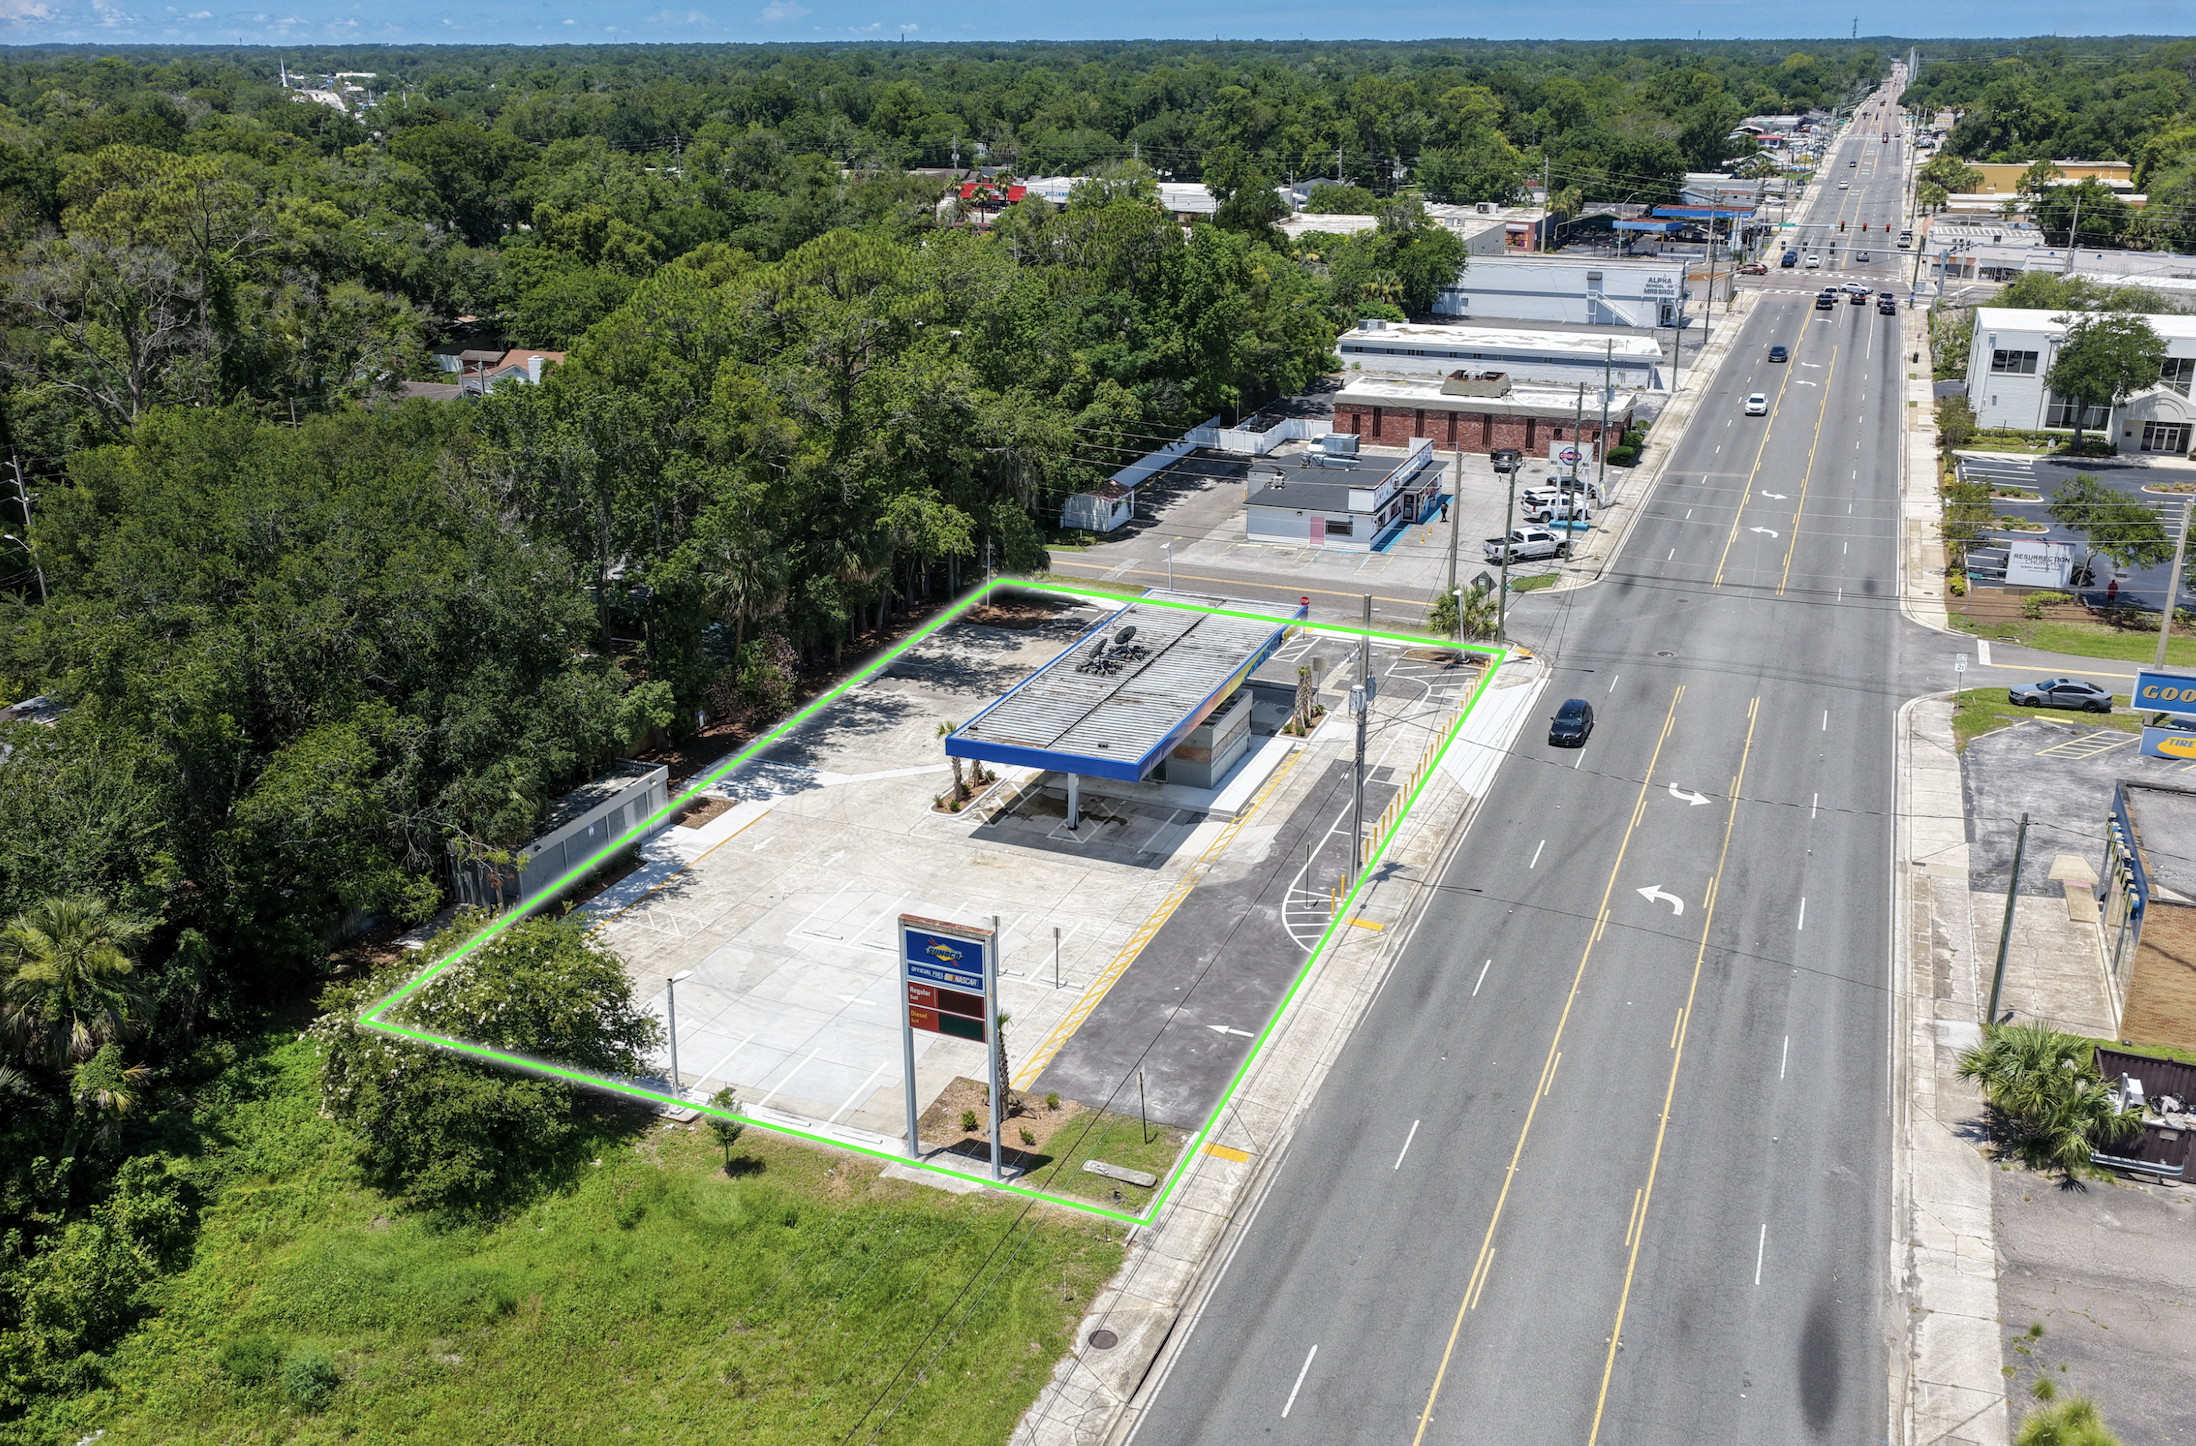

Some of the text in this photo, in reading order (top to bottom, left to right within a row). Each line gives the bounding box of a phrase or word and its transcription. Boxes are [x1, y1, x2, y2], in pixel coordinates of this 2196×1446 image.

[2013, 553, 2071, 563] RESURRECTION
[2142, 685, 2196, 703] GOO
[2168, 738, 2195, 748] TIRE
[927, 946, 962, 960] SUNOCO
[910, 966, 978, 986] OFFICIAL FUEL NASCAR
[910, 986, 931, 996] Regular
[910, 1010, 928, 1019] Diesel
